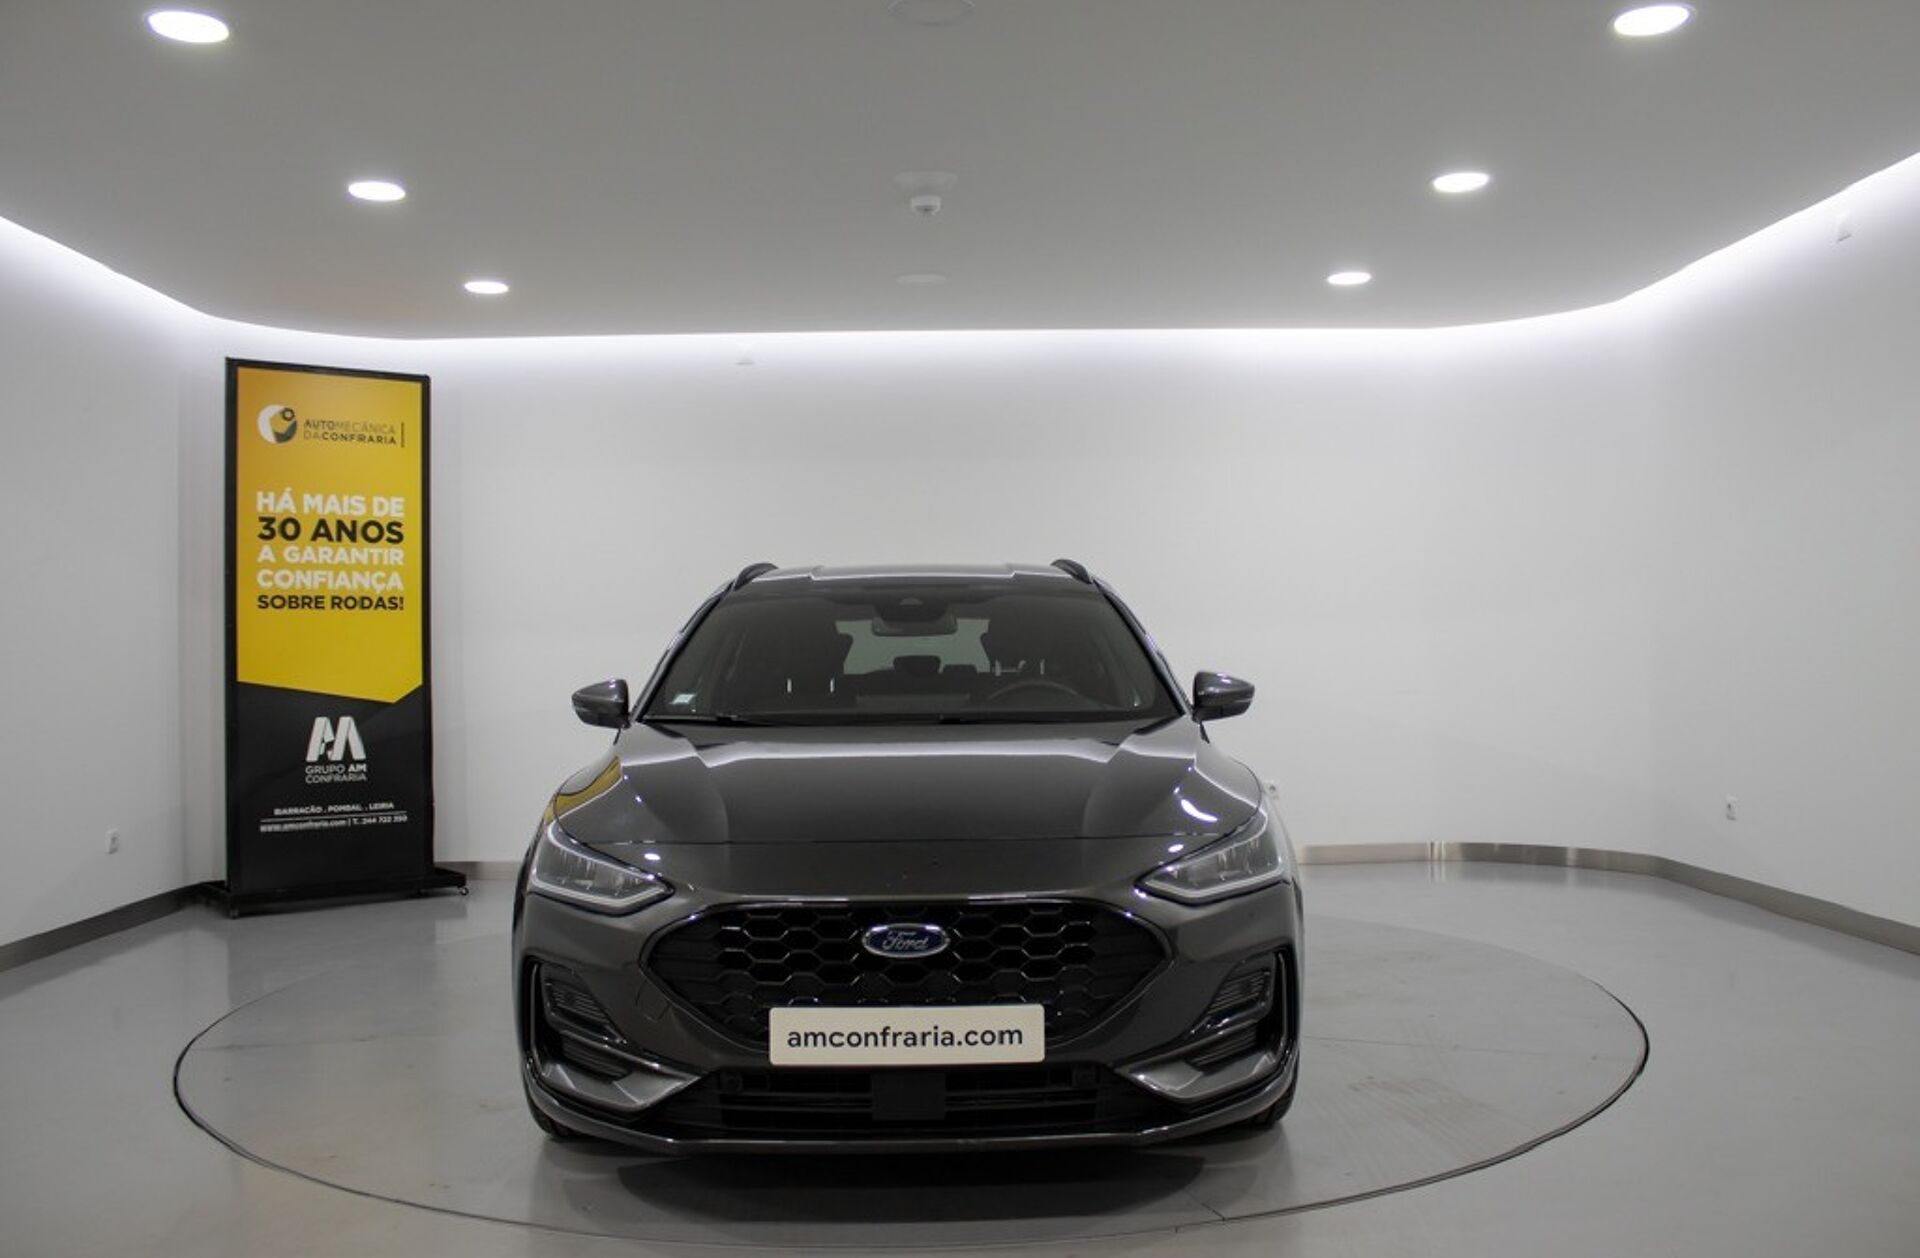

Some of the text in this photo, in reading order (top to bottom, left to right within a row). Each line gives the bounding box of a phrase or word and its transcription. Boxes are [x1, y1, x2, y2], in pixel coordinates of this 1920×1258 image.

[256, 486, 405, 518] HÁ MAIS DE
[257, 516, 405, 544] 30 ANOS
[256, 545, 404, 566] A GARANTIR
[256, 569, 404, 594] CONFIANÇA
[257, 595, 404, 611] SOBRE RODAS!
[305, 763, 368, 775] GRUPO AM
[305, 773, 368, 784] CONFRARIA
[882, 930, 929, 950] Ford
[787, 1026, 1023, 1048] amconfraria.com
